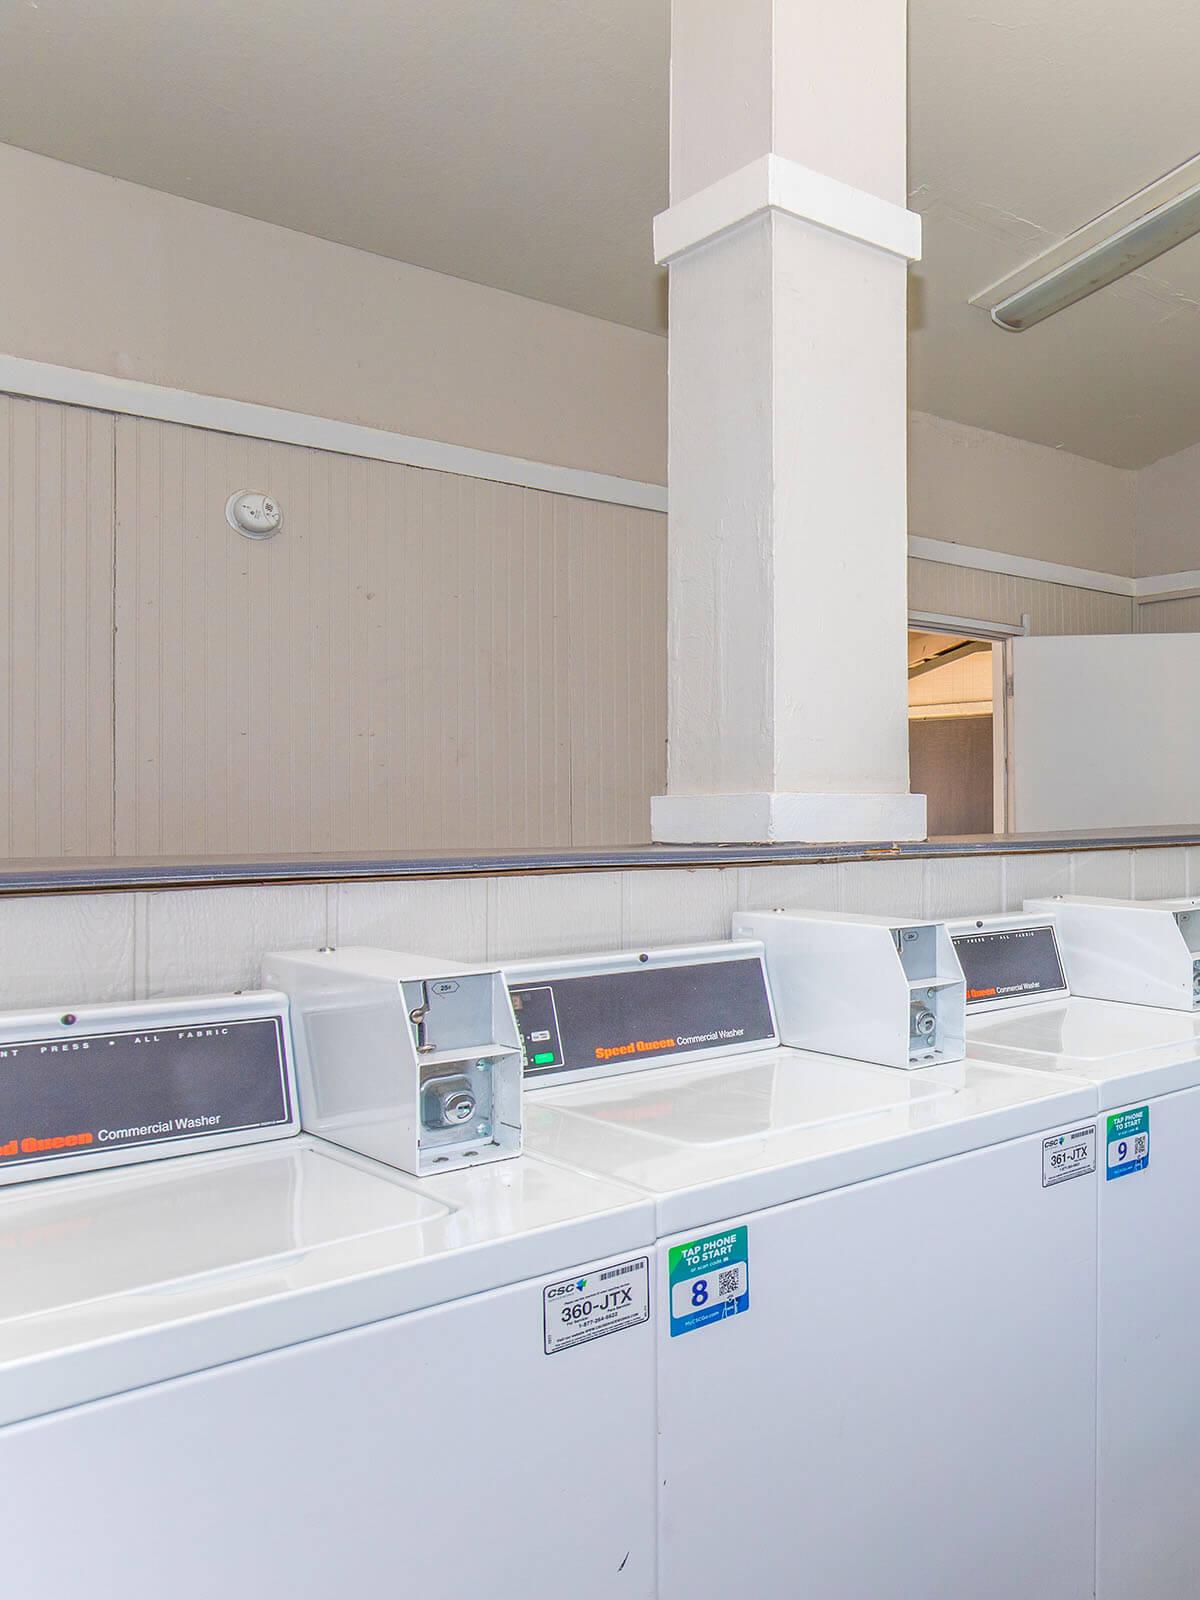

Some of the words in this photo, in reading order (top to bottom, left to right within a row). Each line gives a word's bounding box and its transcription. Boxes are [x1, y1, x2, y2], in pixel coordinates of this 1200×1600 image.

[40, 1042, 90, 1054] PRESS
[134, 1035, 160, 1044] ALL
[178, 1028, 228, 1040] FABRIC
[595, 1042, 635, 1060] Speed
[636, 1037, 676, 1053] Queen
[676, 1031, 719, 1046] Commercial
[718, 1027, 744, 1039] Washer
[1113, 1116, 1124, 1125] TAP
[1124, 1111, 1143, 1121] PHONE
[1115, 1122, 1123, 1131] TO
[1123, 1118, 1141, 1130] START
[21, 1132, 94, 1153] Queen
[98, 1120, 173, 1142] Commercial
[175, 1114, 221, 1131] Washer
[1044, 1139, 1058, 1149] CSC
[1050, 1145, 1088, 1167] 361-JTX
[1117, 1141, 1128, 1161] 9
[681, 1245, 701, 1259] TAP
[703, 1234, 737, 1252] PHONE
[686, 1255, 700, 1266] TO
[702, 1244, 733, 1262] START
[547, 1283, 575, 1299] CSC
[691, 1279, 708, 1307] 8
[561, 1286, 633, 1323] 360-JTX
